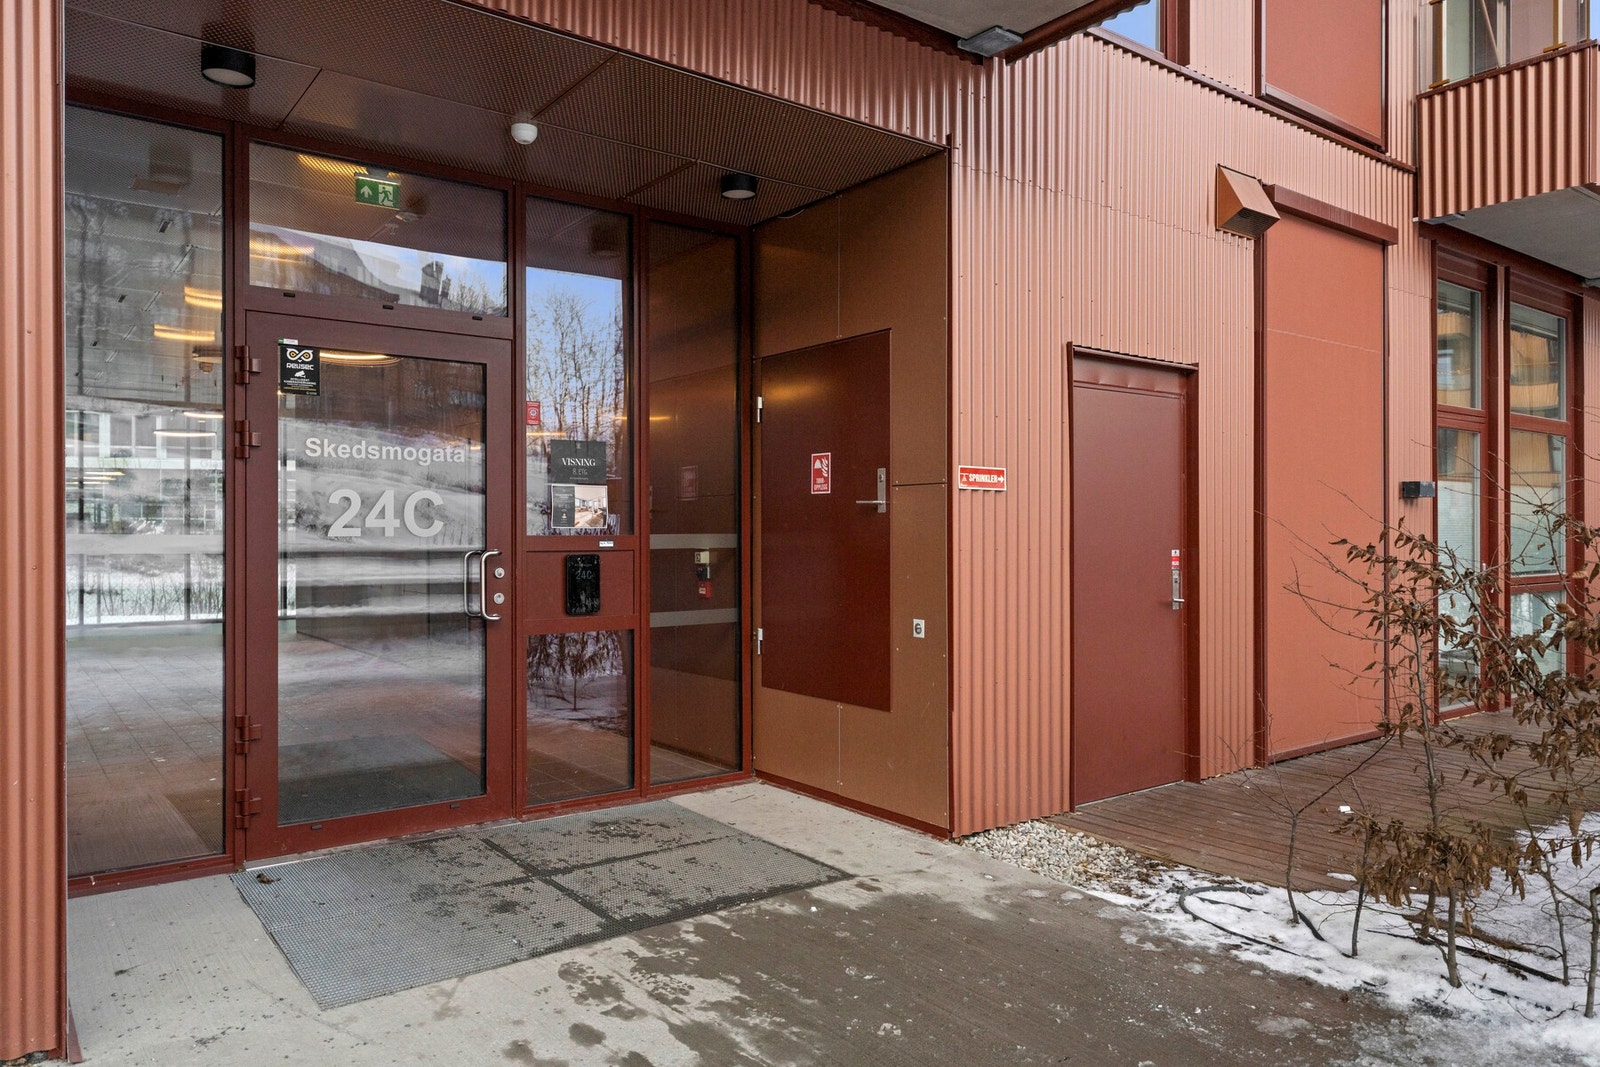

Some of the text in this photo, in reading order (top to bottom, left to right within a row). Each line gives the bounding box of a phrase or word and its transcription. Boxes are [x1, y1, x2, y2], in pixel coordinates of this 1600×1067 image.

[305, 437, 465, 466] Skedsmogata
[561, 457, 596, 467] VISNING
[968, 473, 998, 483] SPRINKLER
[327, 488, 445, 538] 24C
